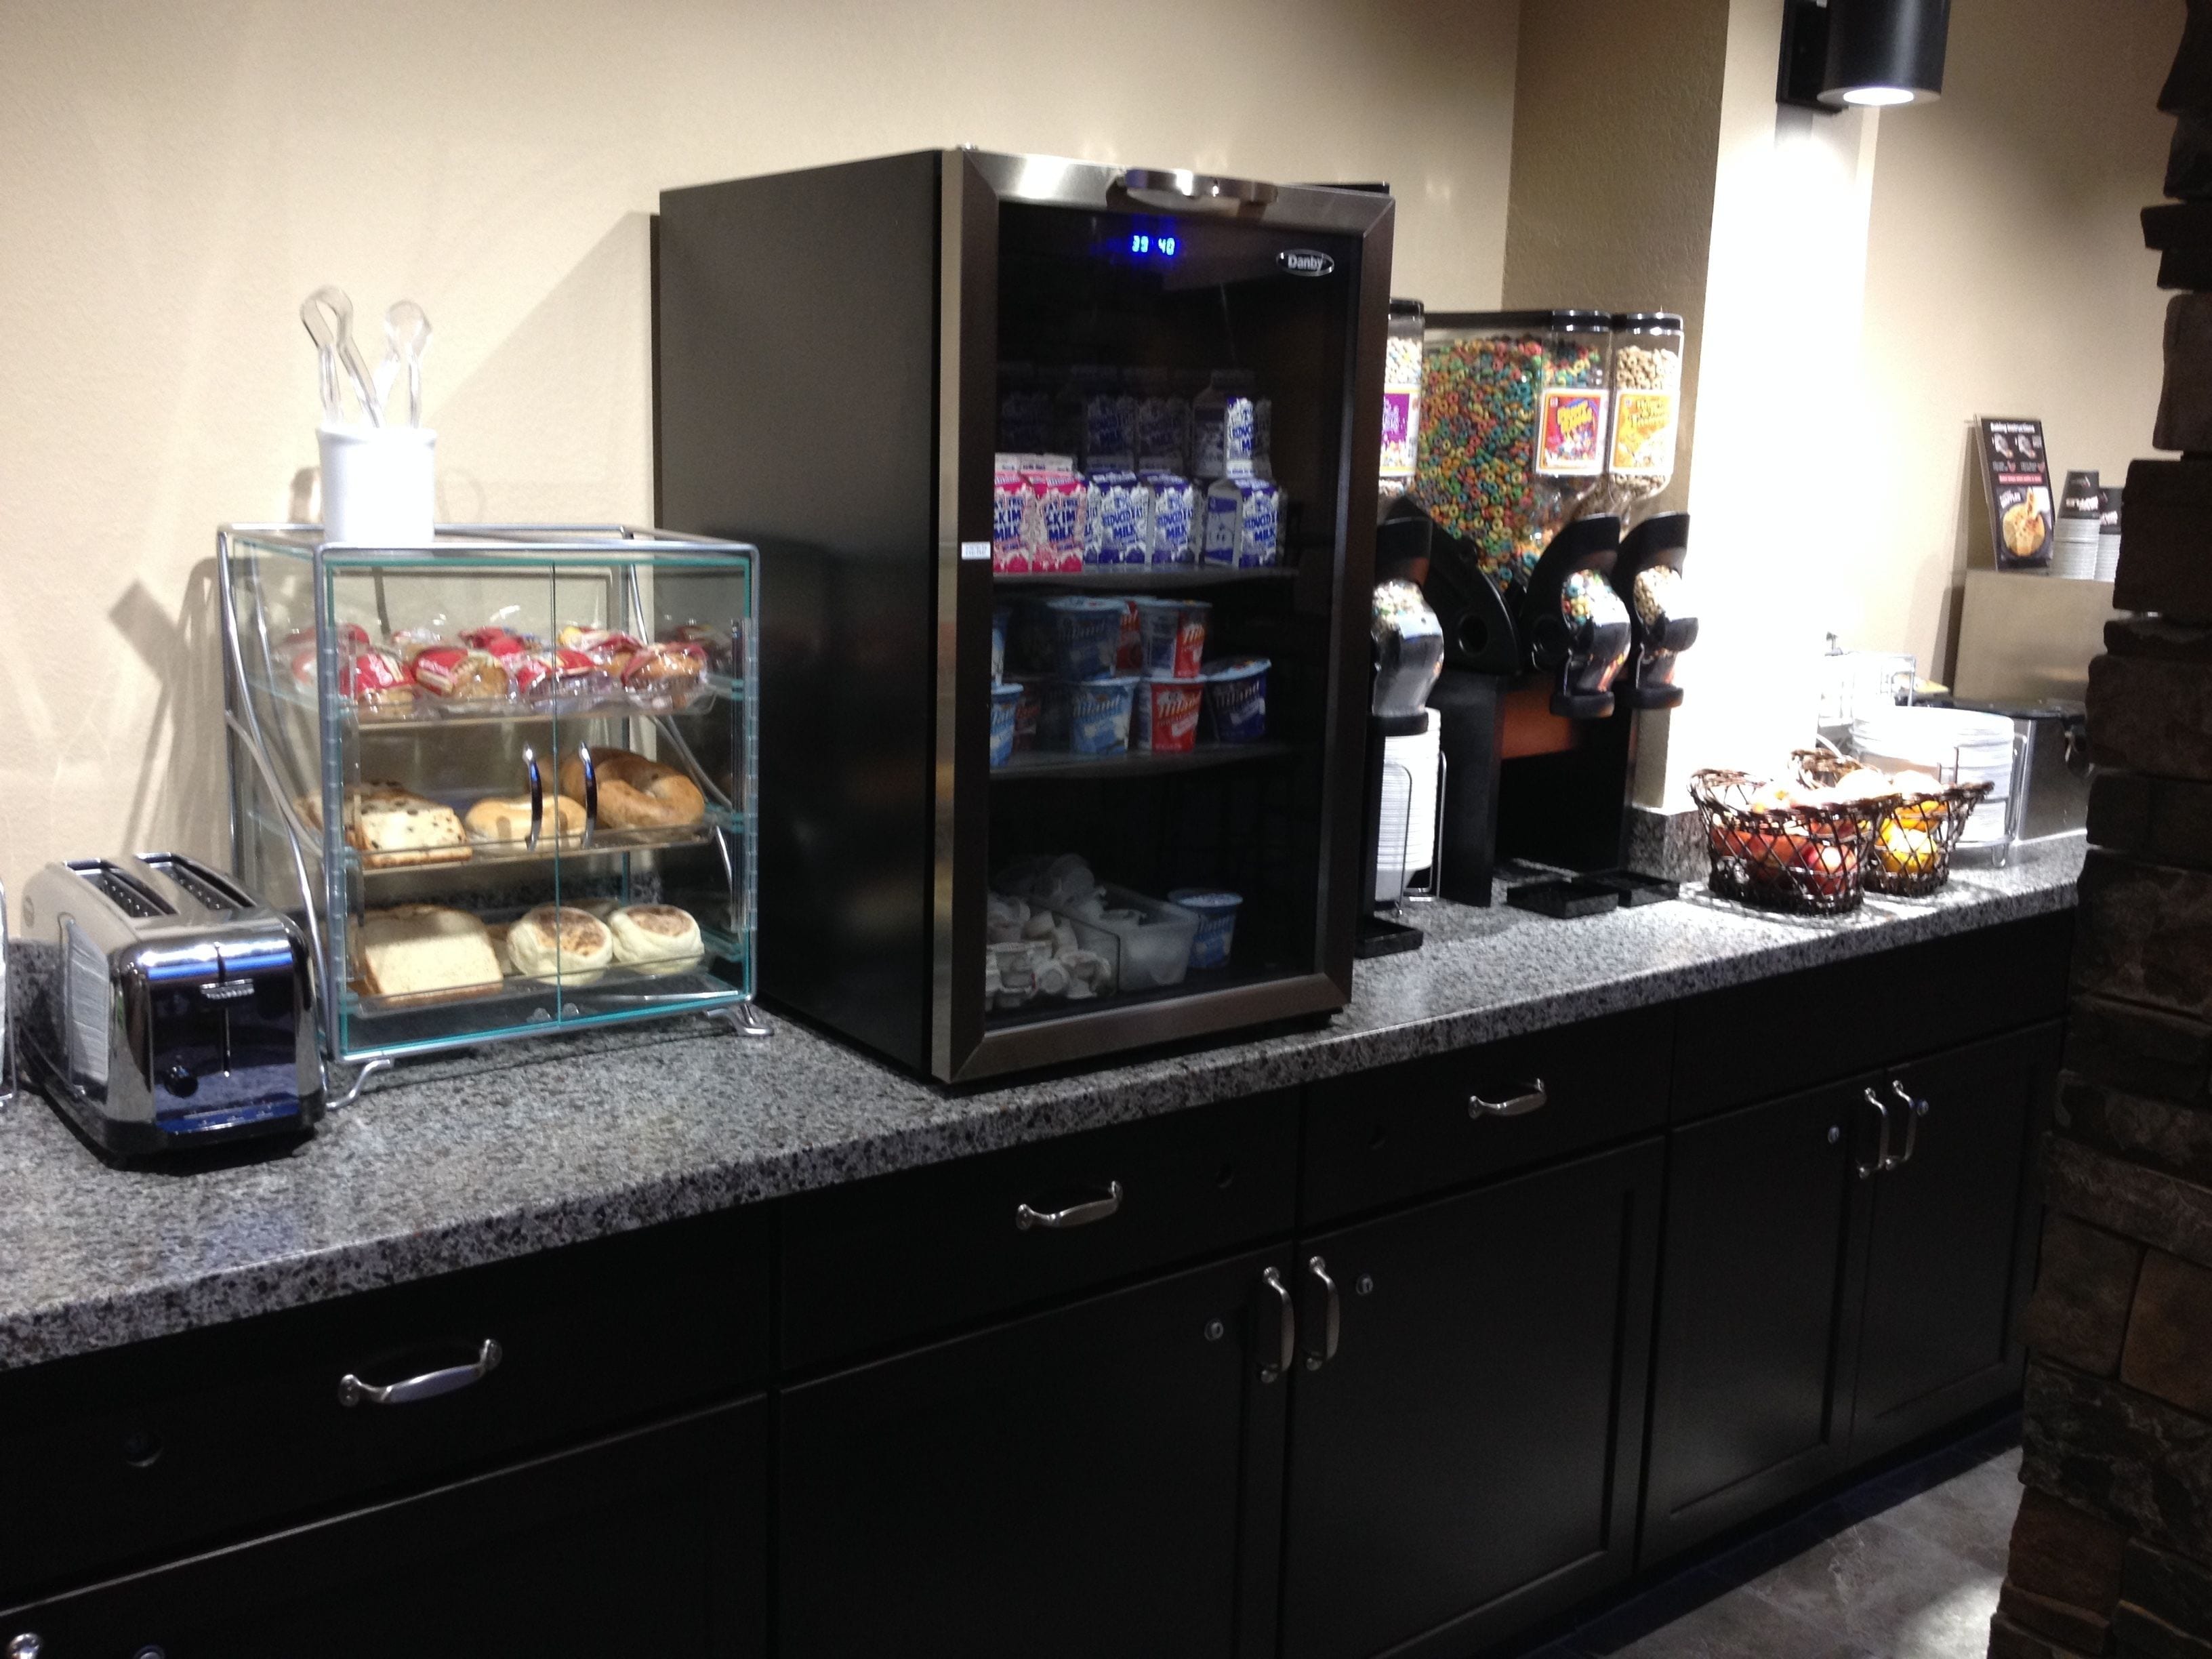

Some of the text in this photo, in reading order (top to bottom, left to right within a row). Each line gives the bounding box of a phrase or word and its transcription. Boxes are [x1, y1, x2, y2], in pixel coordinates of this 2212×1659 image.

[1288, 253, 1324, 272] Danby
[1048, 525, 1075, 543] MILK
[1113, 524, 1136, 539] MILK
[1166, 524, 1187, 539] MILK
[1254, 527, 1275, 542] MILK
